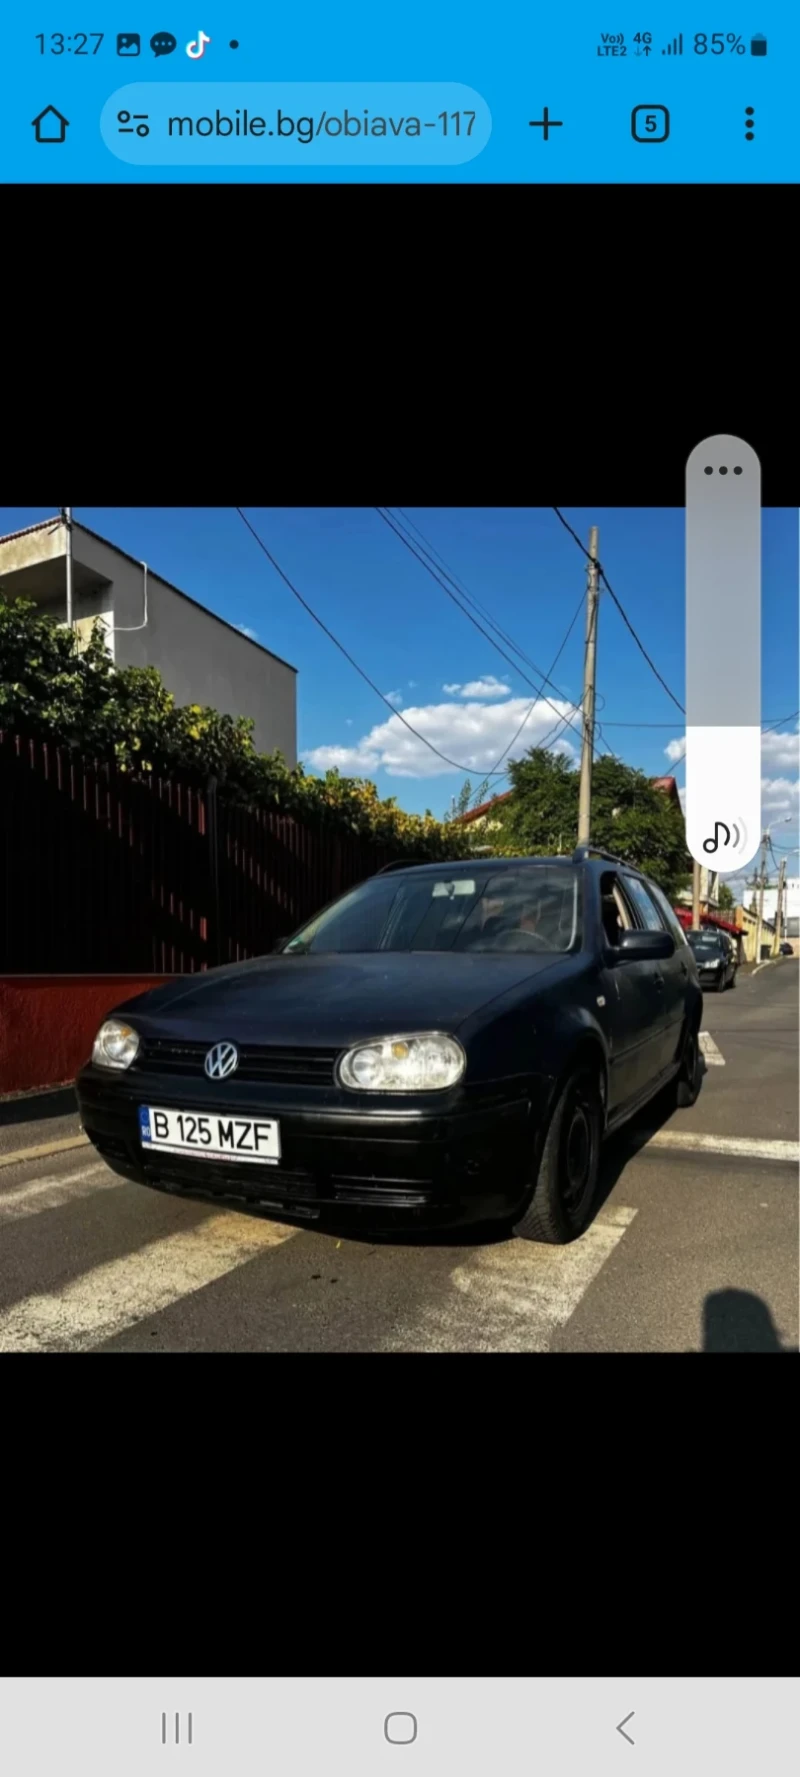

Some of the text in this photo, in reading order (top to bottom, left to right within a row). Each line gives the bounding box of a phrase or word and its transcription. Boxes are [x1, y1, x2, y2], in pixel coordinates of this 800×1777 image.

[35, 32, 105, 55] 13:27
[633, 32, 653, 44] 4G
[693, 33, 746, 56] 85%
[597, 46, 627, 57] LTE2
[168, 109, 476, 144] mobile.bg/obiava-117
[644, 115, 657, 132] 5
[142, 1126, 151, 1137] RO
[153, 1112, 272, 1151] B 125 MZF
